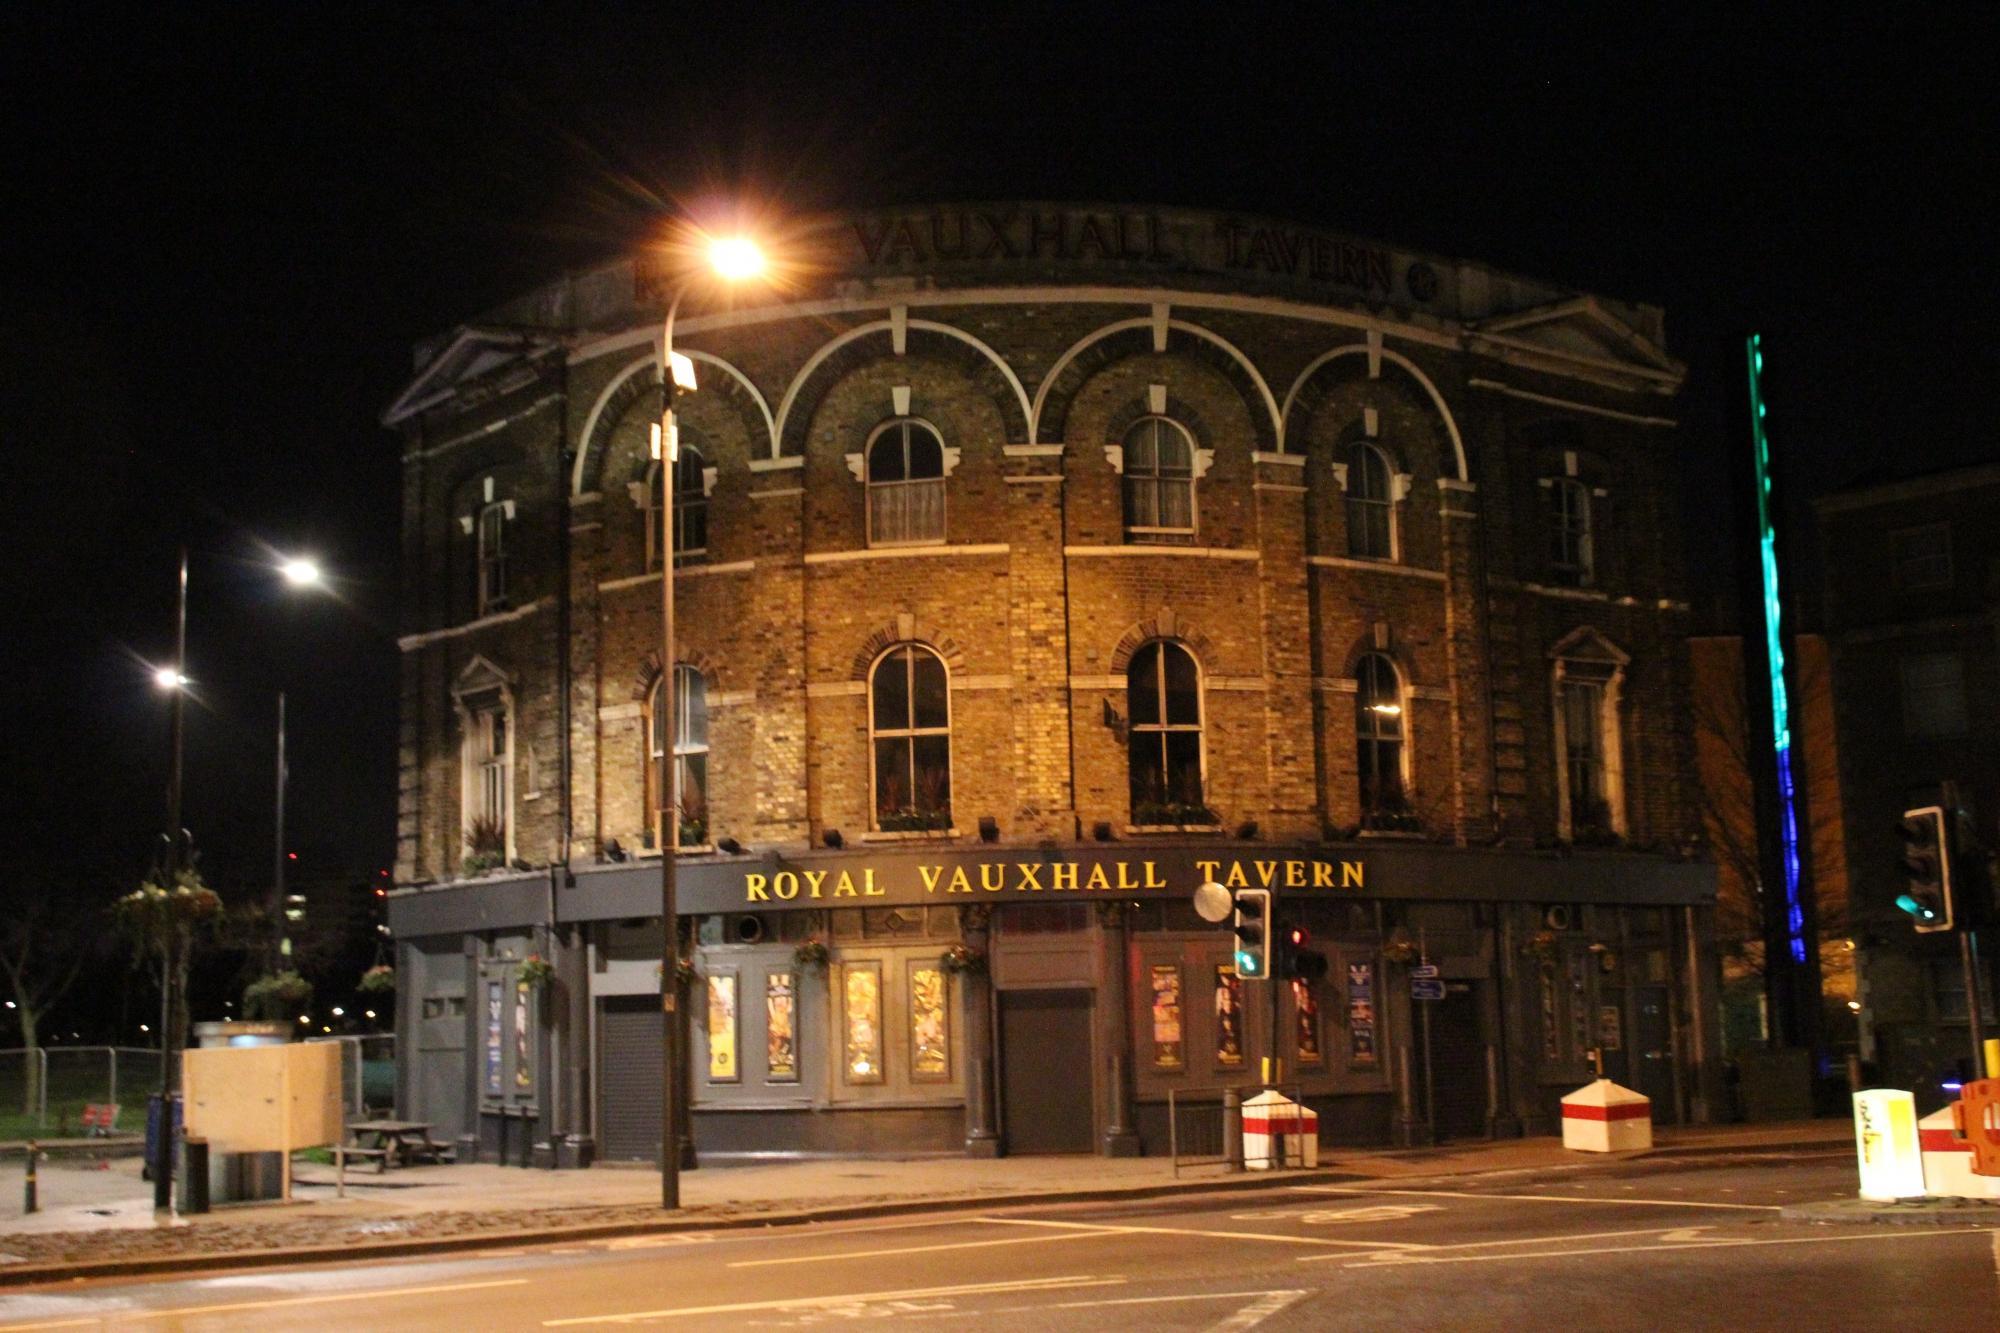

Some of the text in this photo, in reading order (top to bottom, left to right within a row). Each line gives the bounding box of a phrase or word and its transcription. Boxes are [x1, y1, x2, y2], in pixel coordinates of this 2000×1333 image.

[849, 206, 1172, 263] VAUXHALL
[1219, 215, 1394, 293] TAVERN
[745, 860, 1364, 901] ROYAL VAUXHALL TAVERN
